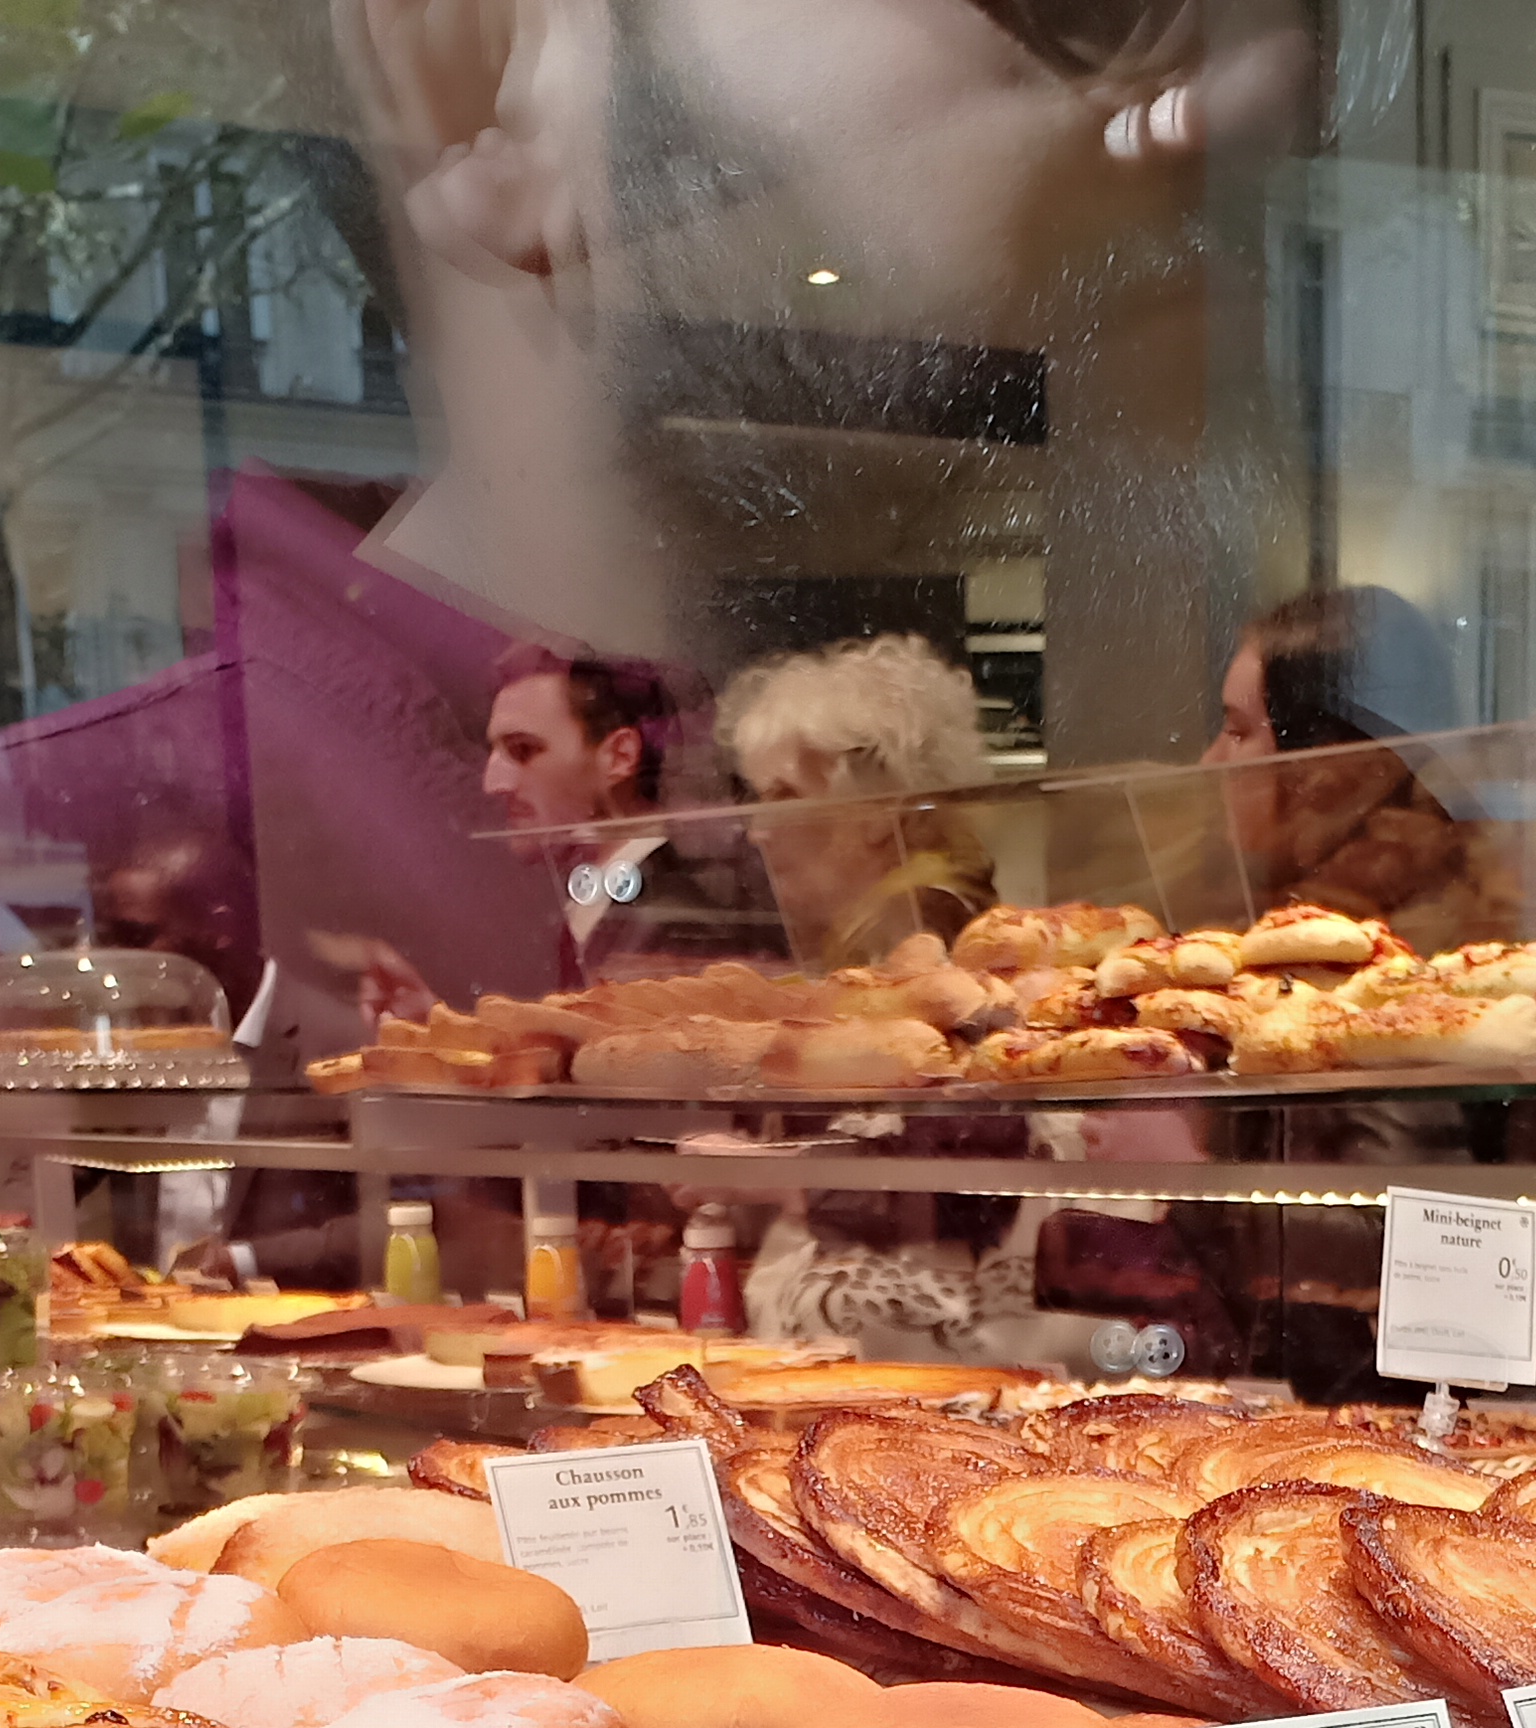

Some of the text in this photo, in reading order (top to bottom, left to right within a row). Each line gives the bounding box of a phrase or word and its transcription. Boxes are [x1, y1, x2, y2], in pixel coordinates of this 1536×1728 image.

[555, 1468, 644, 1486] Chausson
[549, 1488, 662, 1511] aux pommes
